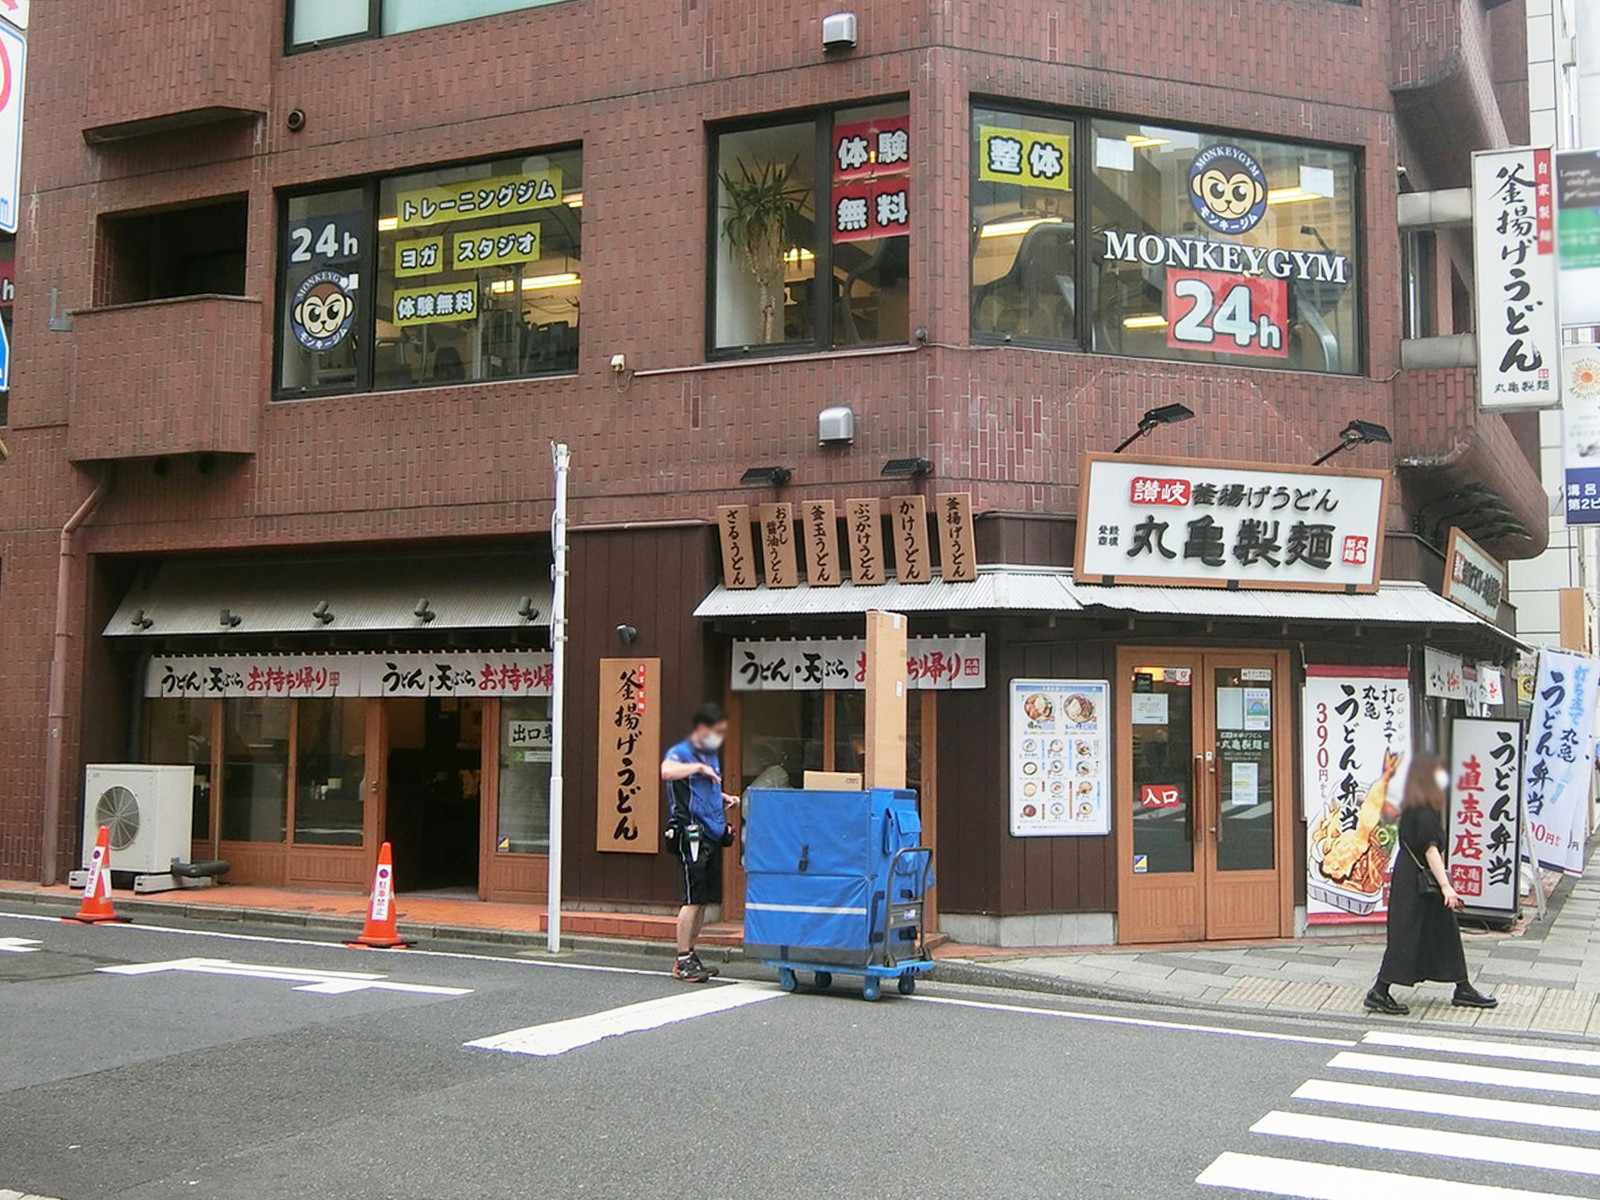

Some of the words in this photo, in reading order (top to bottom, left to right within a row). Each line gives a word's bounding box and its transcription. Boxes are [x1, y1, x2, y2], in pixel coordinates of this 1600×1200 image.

[837, 131, 908, 170] 体験
[988, 136, 1062, 178] 整体
[1195, 147, 1260, 177] MONKEYGYM
[403, 180, 556, 222] トレーニングジム
[837, 192, 908, 231] 無料
[1200, 206, 1257, 231] モンキージム
[291, 224, 359, 263] 24h
[401, 244, 438, 269] ヨガ
[458, 232, 536, 261] スタジオ
[1103, 230, 1347, 284] MONKEYGYM
[1488, 163, 1543, 373] 釜揚げうどん
[398, 291, 474, 319] 体験無料
[1174, 279, 1282, 349] 24h
[1493, 380, 1549, 393] 丸亀製麺
[1134, 480, 1188, 504] 讃岐
[1190, 482, 1340, 513] 釜揚げうどん
[775, 507, 789, 545] おろし
[811, 505, 831, 582] 釜玉うどん
[854, 503, 876, 581] ぶっかけうどん
[899, 500, 920, 579] かけうどん
[946, 497, 966, 578] 釜揚げうどん
[1126, 514, 1336, 569] 丸亀製麺
[766, 521, 783, 585] 醤油うどん
[161, 665, 245, 693] うどん・天ぷら
[246, 665, 328, 693] お持ち帰り
[382, 662, 477, 692] うどん・天ぷら
[740, 650, 849, 685] うどん・天ぷら
[1362, 685, 1381, 721] 丸亀
[1382, 684, 1398, 744] 打ち立て
[613, 669, 644, 841] 釜揚げうどん
[1316, 702, 1330, 800] 390円から
[1334, 684, 1363, 833] うどん弁当
[1527, 671, 1565, 816] うどん弁当
[1556, 728, 1579, 763] 丸亀
[1143, 788, 1179, 805] 入口
[1451, 754, 1485, 861] 直売店
[1486, 731, 1517, 886] うどん弁当
